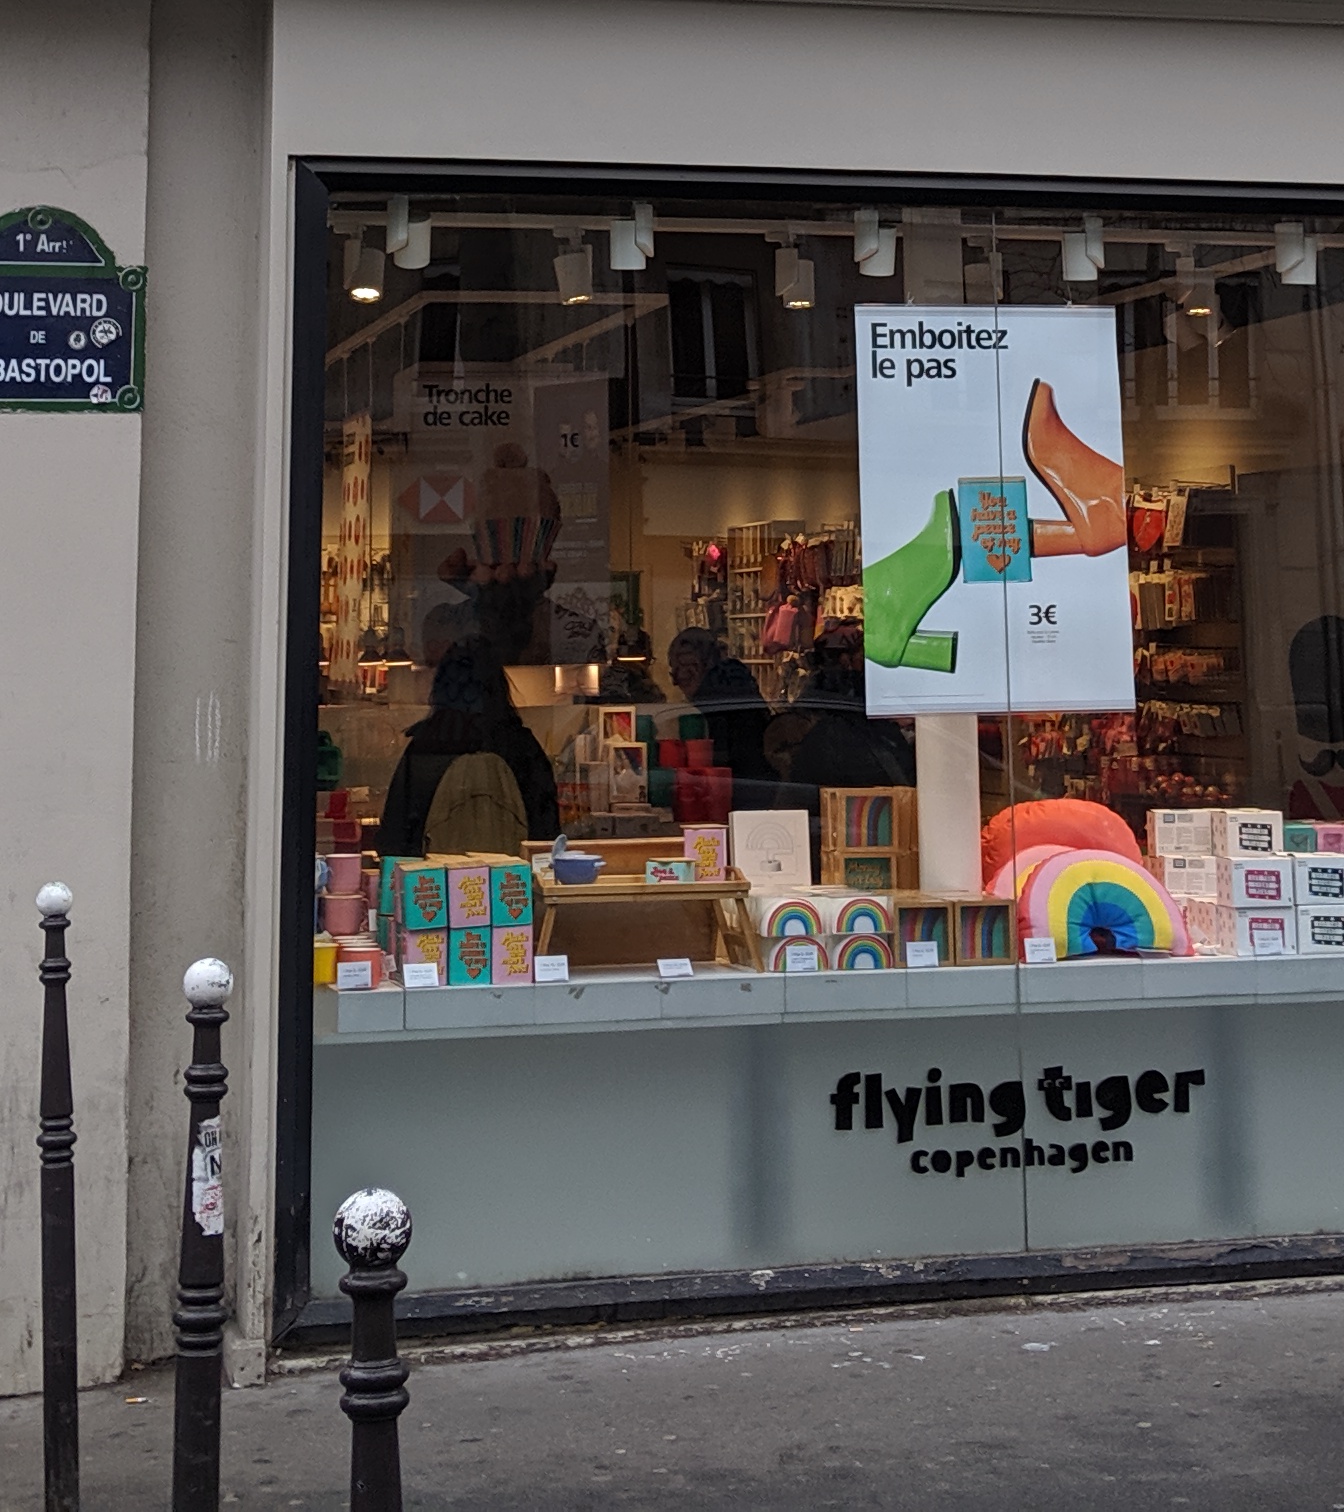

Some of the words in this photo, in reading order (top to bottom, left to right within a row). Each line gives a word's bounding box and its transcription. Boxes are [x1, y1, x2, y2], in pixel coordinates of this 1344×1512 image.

[29, 331, 46, 344] DE
[871, 321, 1008, 349] Emboitez
[871, 350, 896, 379] le
[906, 358, 957, 387] pas
[423, 383, 513, 404] Tronche
[423, 405, 452, 426] de
[457, 405, 510, 426] cake
[561, 433, 579, 448] 1€
[1029, 604, 1057, 625] 3€
[830, 1068, 1026, 1144] flying
[1037, 1066, 1206, 1131] tiger
[910, 1138, 1134, 1178] copenhagen
